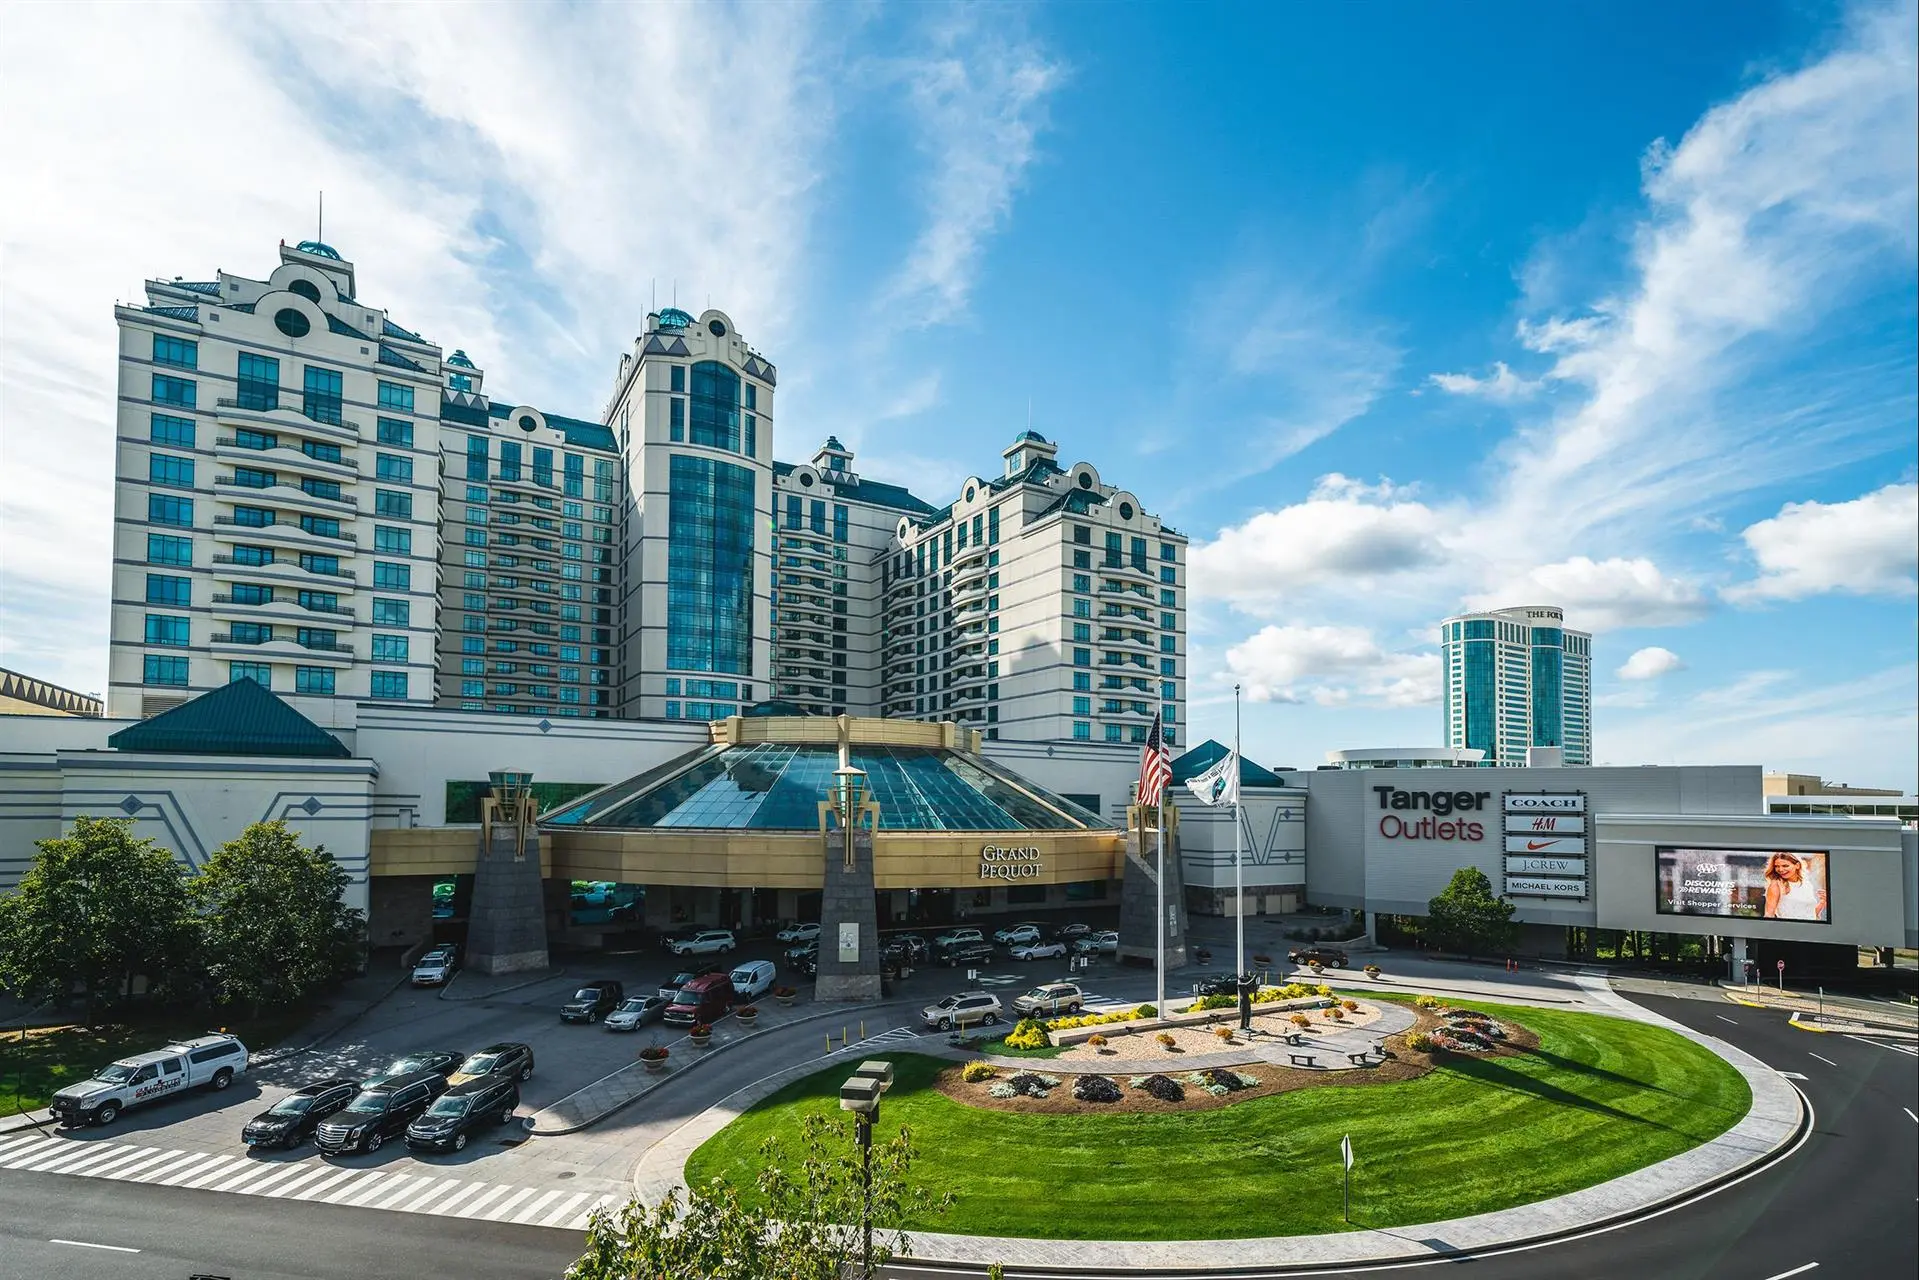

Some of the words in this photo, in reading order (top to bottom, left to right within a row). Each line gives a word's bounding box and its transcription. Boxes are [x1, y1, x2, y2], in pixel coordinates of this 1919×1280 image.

[1526, 610, 1545, 618] THE
[1373, 786, 1490, 816] Tanger
[1511, 799, 1577, 807] COACH
[1380, 815, 1484, 841] Outlets
[1531, 817, 1556, 831] H&M
[983, 845, 1040, 862] GRAND
[1522, 860, 1568, 872] J.CREW
[980, 863, 1043, 882] PEQUOT
[1511, 882, 1552, 891] MICHAEL
[1554, 884, 1580, 892] KORS
[1684, 879, 1736, 888] DISCOUNTS
[1688, 887, 1737, 895] REWARDS
[1687, 900, 1721, 908] Shopper
